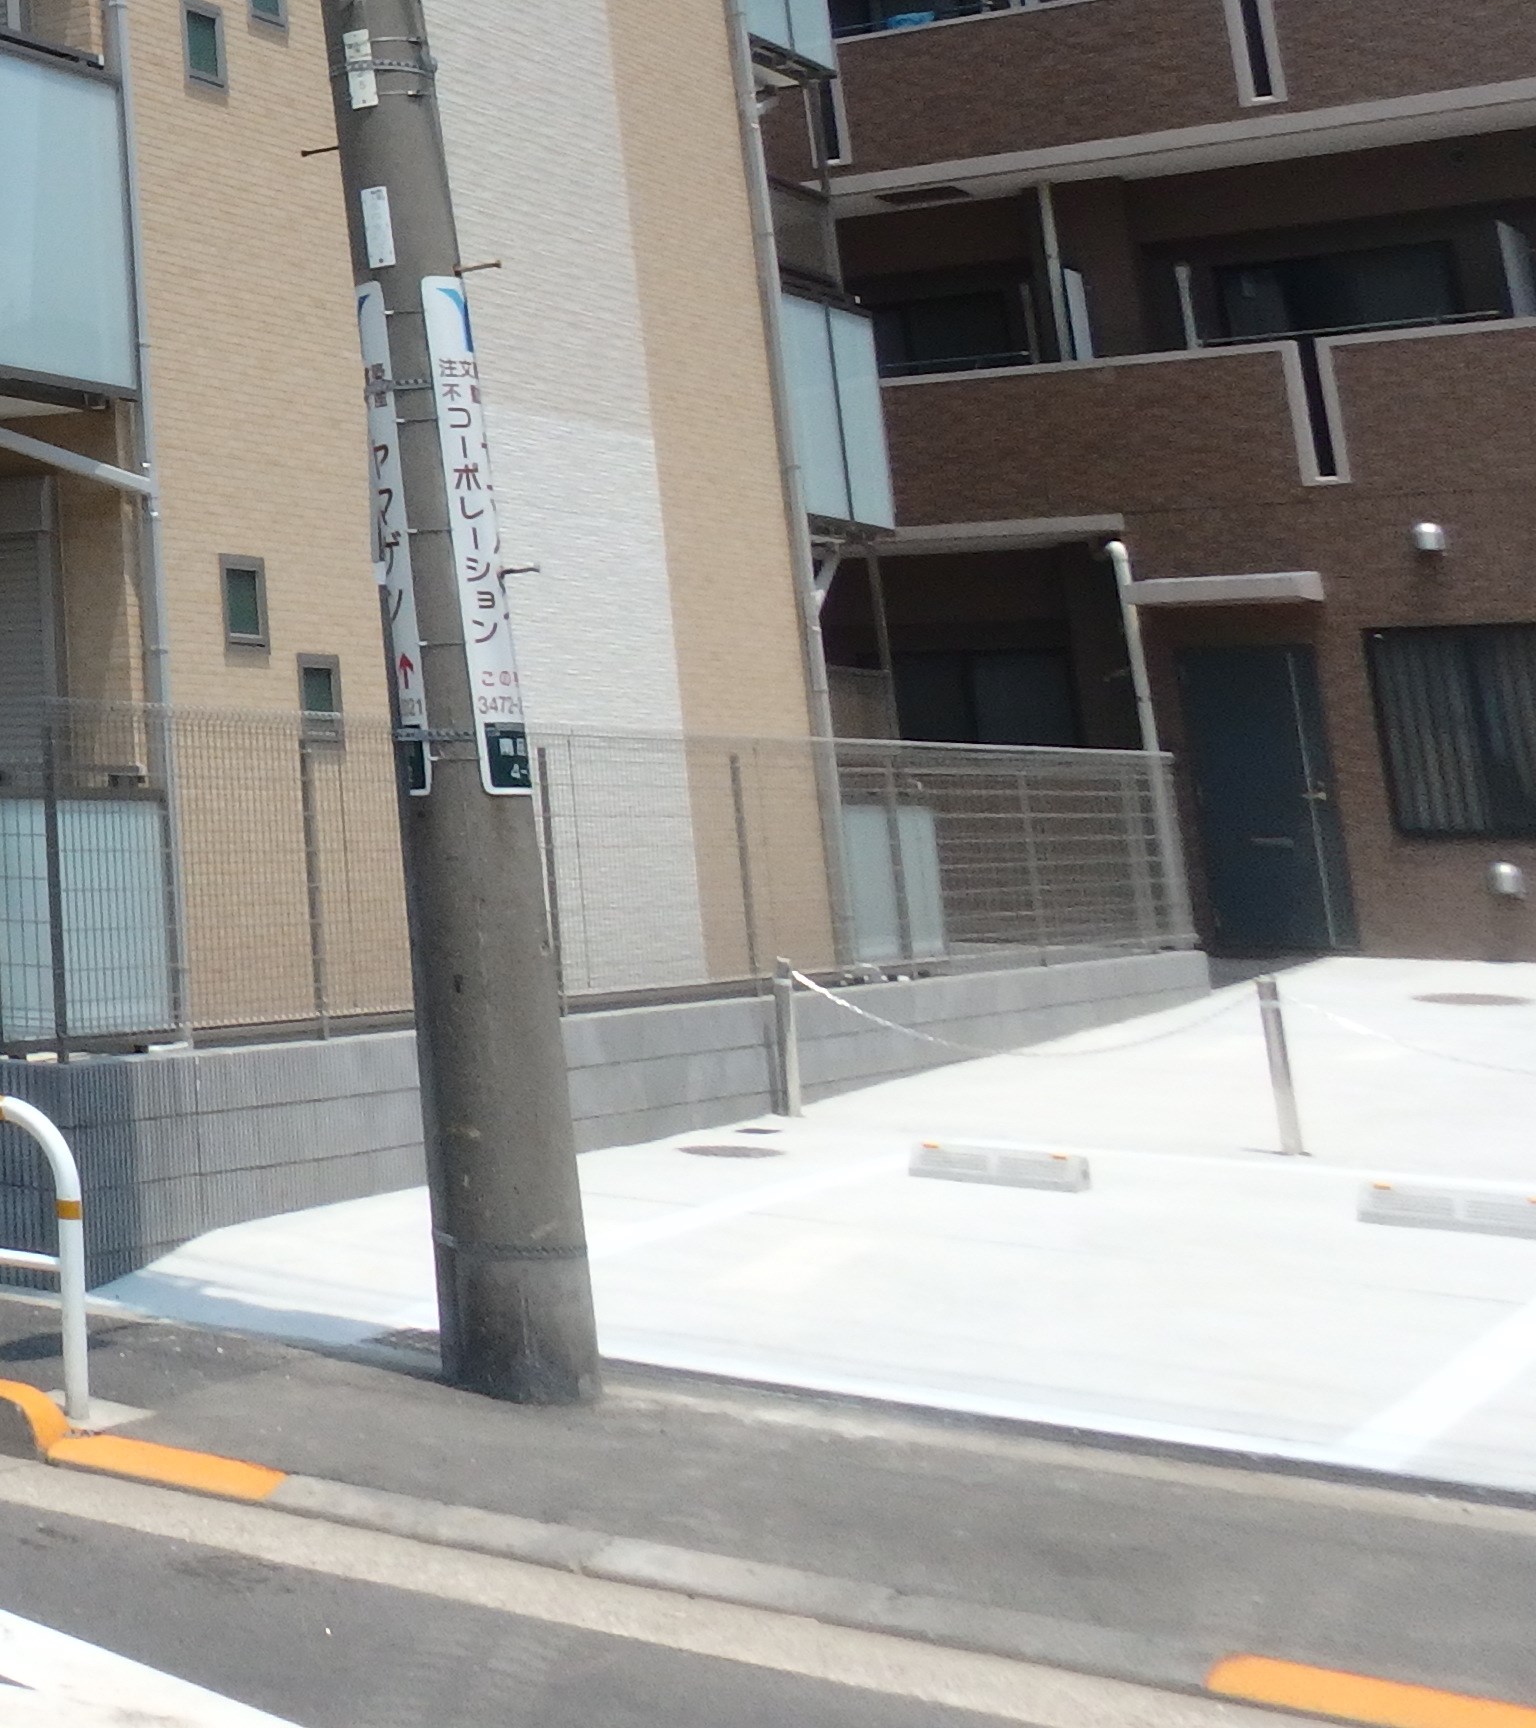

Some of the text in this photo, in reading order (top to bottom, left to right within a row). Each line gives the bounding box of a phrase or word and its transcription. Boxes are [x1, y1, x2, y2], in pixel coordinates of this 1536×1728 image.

[447, 407, 498, 644] コーポレーション
